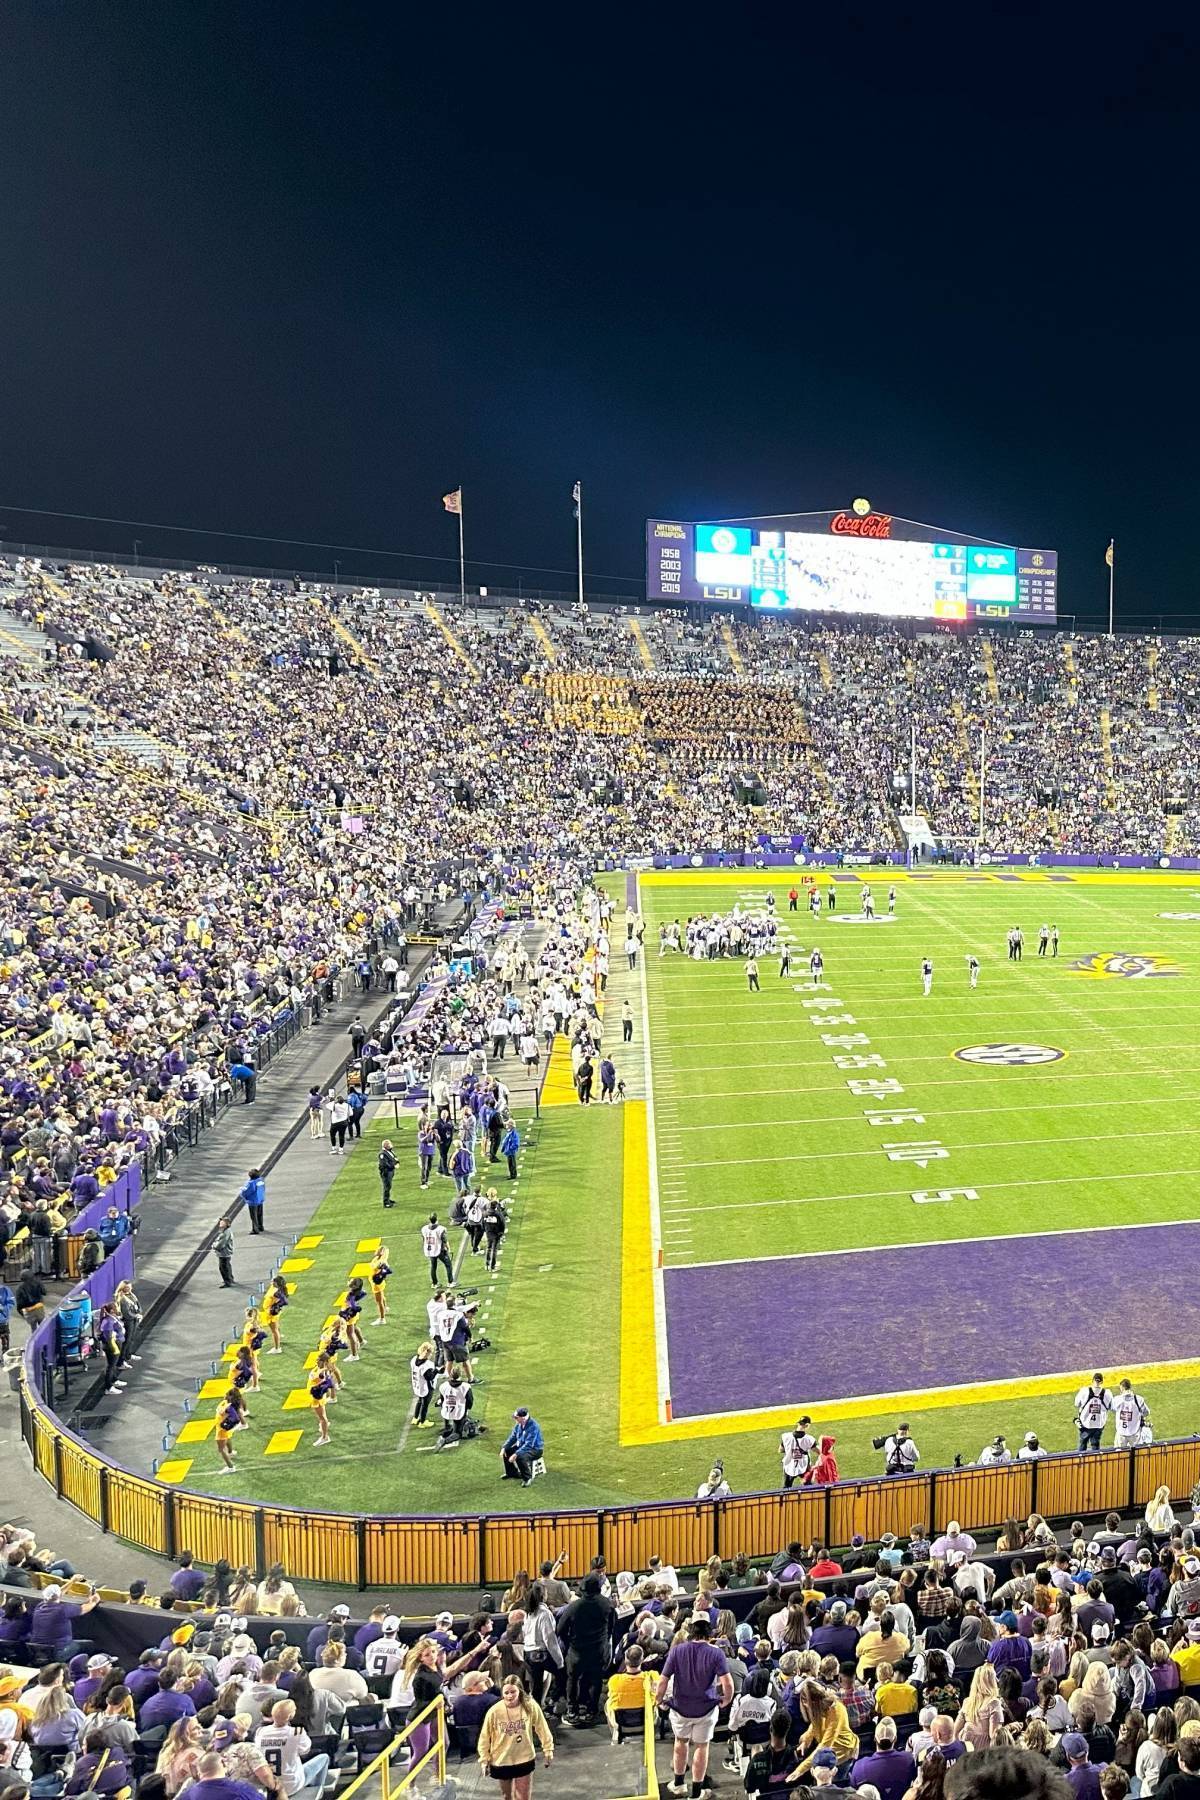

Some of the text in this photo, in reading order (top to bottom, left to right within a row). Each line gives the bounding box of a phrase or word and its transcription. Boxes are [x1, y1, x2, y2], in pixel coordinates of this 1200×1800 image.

[831, 513, 891, 538] Coca-Cola
[661, 548, 680, 558] 1958
[660, 560, 681, 570] 2003
[660, 571, 681, 581] 2007
[661, 583, 680, 593] 2019
[703, 586, 741, 600] LSU
[976, 604, 1010, 618] LSU
[1020, 630, 1034, 638] 235
[846, 1078, 905, 1096] 20
[863, 1107, 927, 1127] 15
[881, 1140, 950, 1162] 10
[910, 1188, 981, 1204] 5
[1091, 1414, 1097, 1422] 4
[1122, 1421, 1128, 1429] 5
[373, 1655, 387, 1675] 9
[742, 1710, 766, 1720] BURROW
[260, 1738, 288, 1747] BURROW
[265, 1749, 283, 1777] 9
